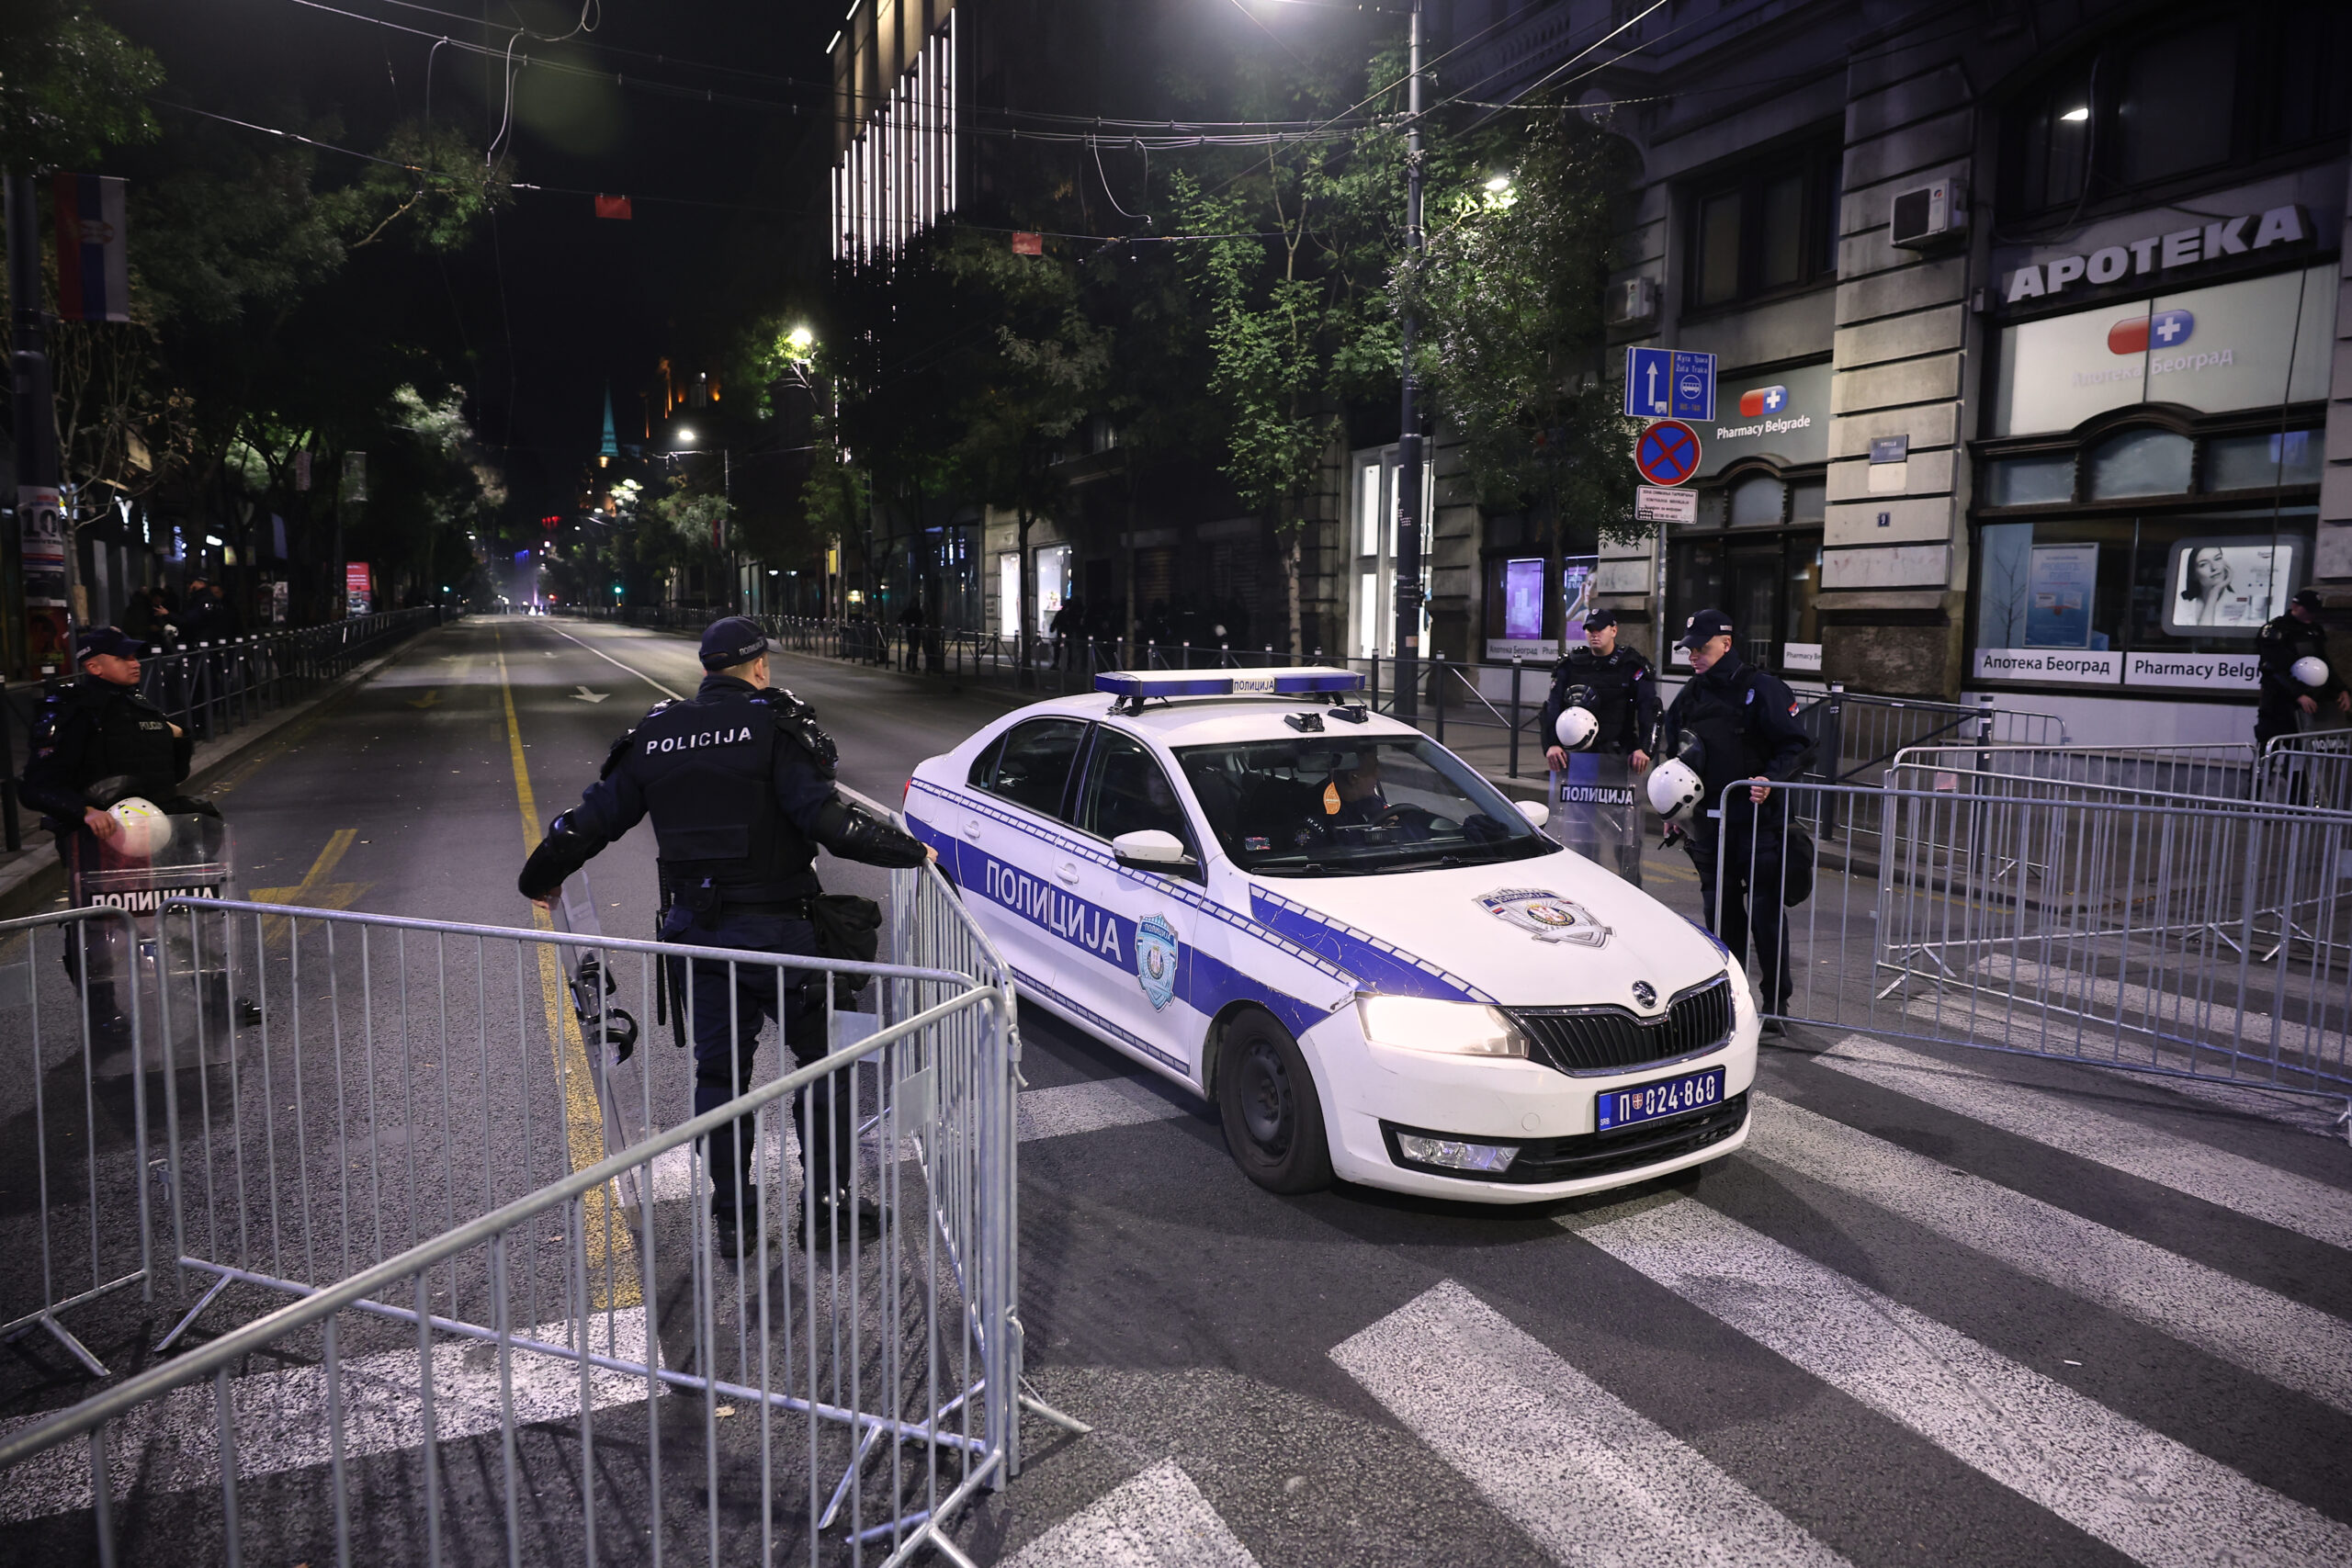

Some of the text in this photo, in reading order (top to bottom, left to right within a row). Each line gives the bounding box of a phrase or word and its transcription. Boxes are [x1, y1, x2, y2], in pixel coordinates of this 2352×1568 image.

[2072, 348, 2233, 388] Апотека Београд
[1716, 415, 1811, 440] Pharmacy Belgrade
[1786, 651, 1814, 660] Pharmacy
[1984, 655, 2110, 675] Апотека Београд
[2135, 660, 2214, 680] Pharmacy
[1234, 680, 1274, 692] ПОЛИЦИЈА
[646, 727, 752, 755] POLICIJA
[1562, 786, 1634, 805] ПОЛИЦИЈА
[986, 859, 1123, 963] ПОЛИЦИЈА
[1620, 1093, 1631, 1122] П
[1600, 1117, 1611, 1126] SRB
